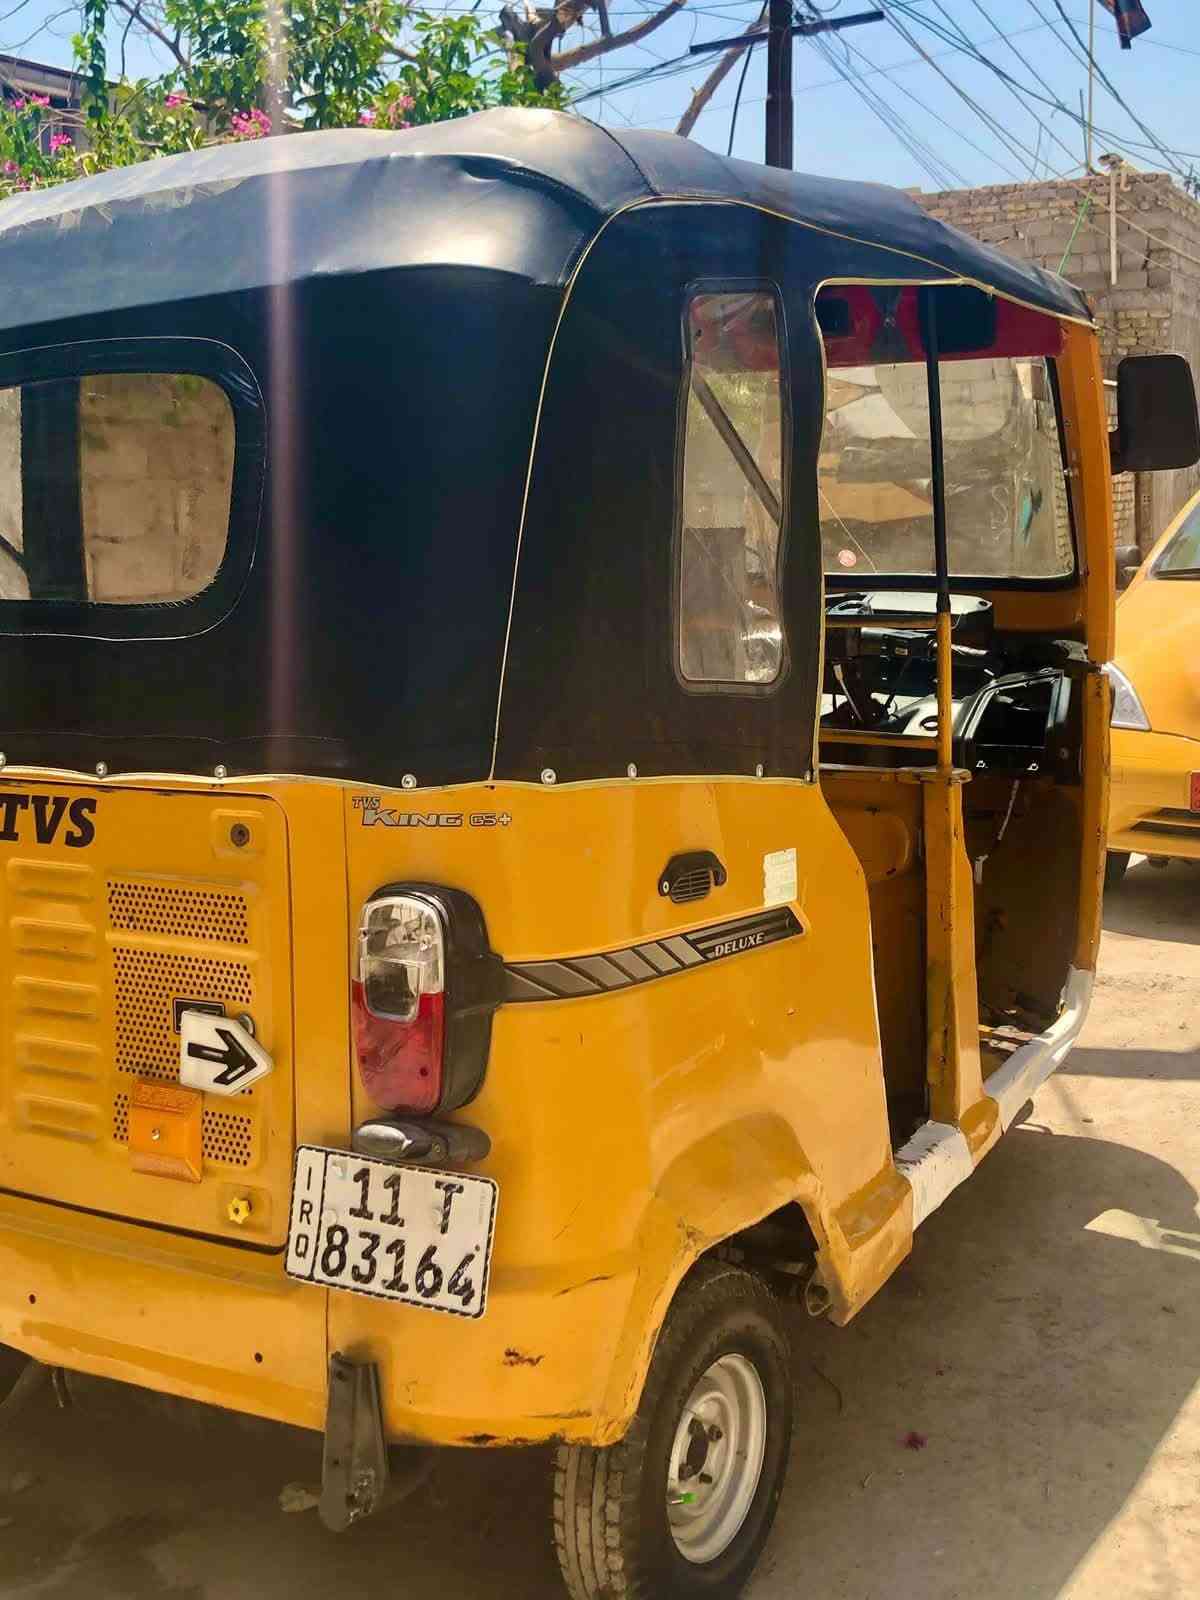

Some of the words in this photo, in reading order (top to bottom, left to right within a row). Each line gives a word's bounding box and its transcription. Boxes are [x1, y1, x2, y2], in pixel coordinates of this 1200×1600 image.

[0, 793, 97, 848] TVS
[352, 796, 381, 809] TVS
[361, 808, 464, 828] KING
[714, 932, 765, 957] DELUXE
[349, 1167, 405, 1228] 11
[434, 1180, 464, 1234] T
[320, 1224, 477, 1306] 83164
